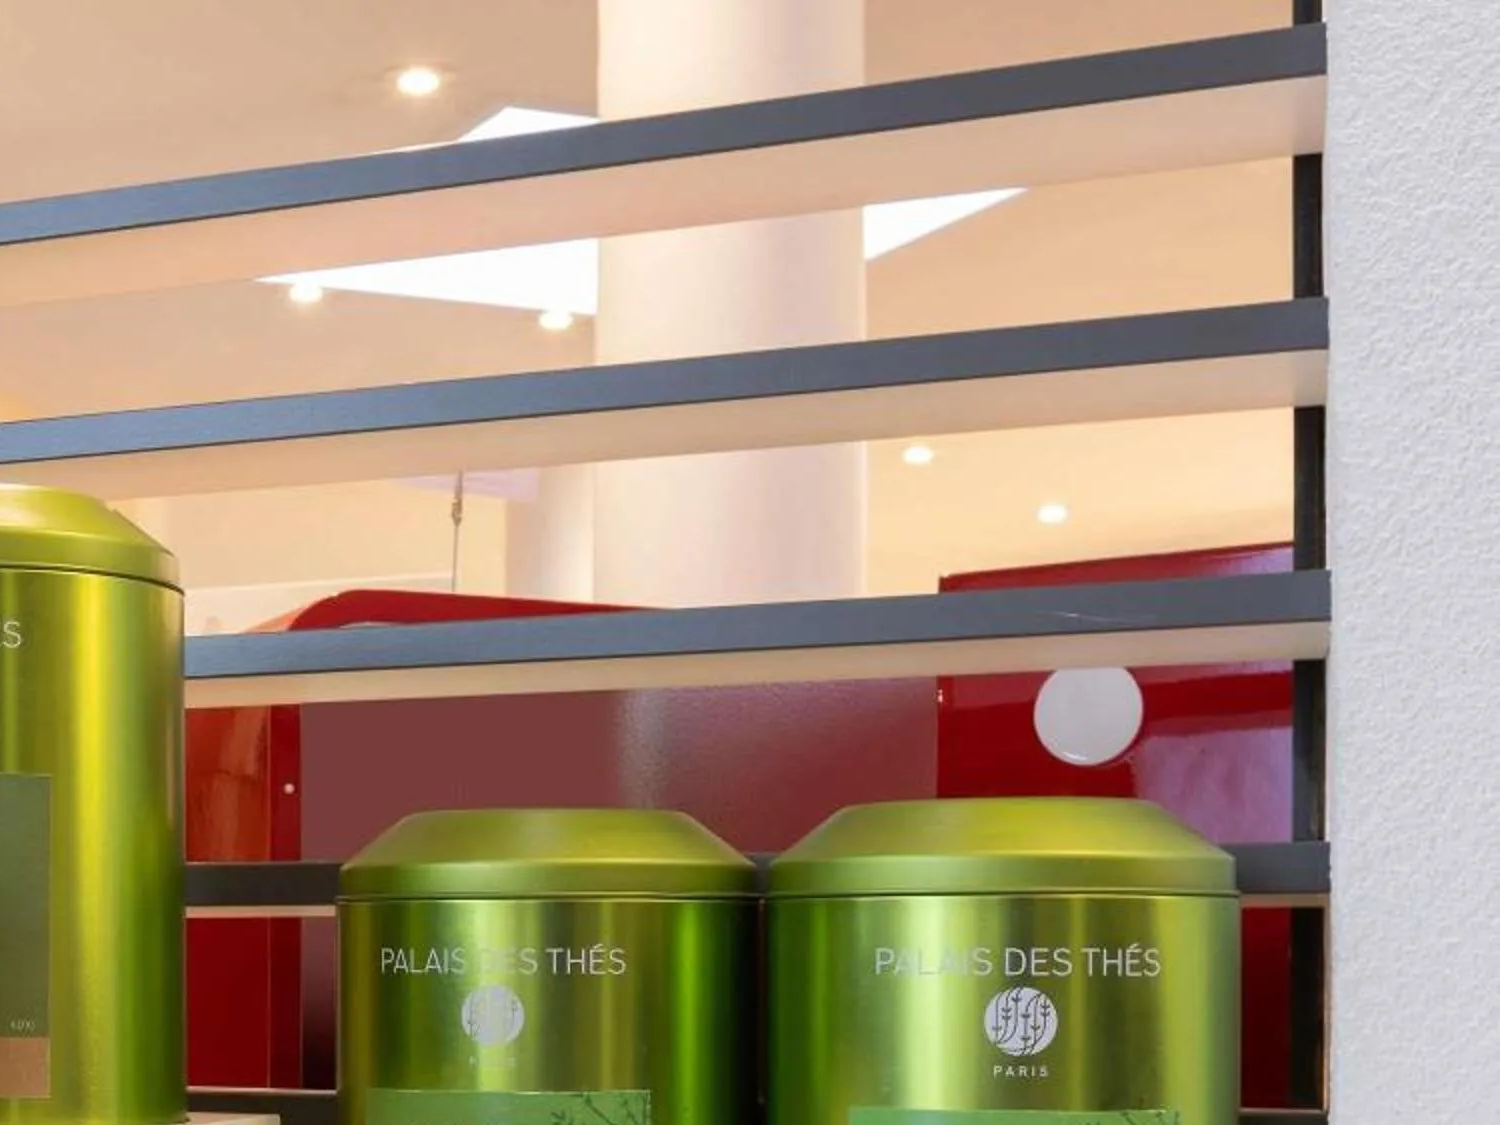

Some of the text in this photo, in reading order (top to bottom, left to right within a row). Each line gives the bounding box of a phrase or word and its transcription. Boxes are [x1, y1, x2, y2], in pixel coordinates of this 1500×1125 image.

[380, 947, 467, 975] PALAIS
[545, 943, 627, 975] THÉS
[1003, 946, 1074, 977] DES
[1081, 942, 1161, 978] THÉS
[993, 1065, 1050, 1078] PARIS
